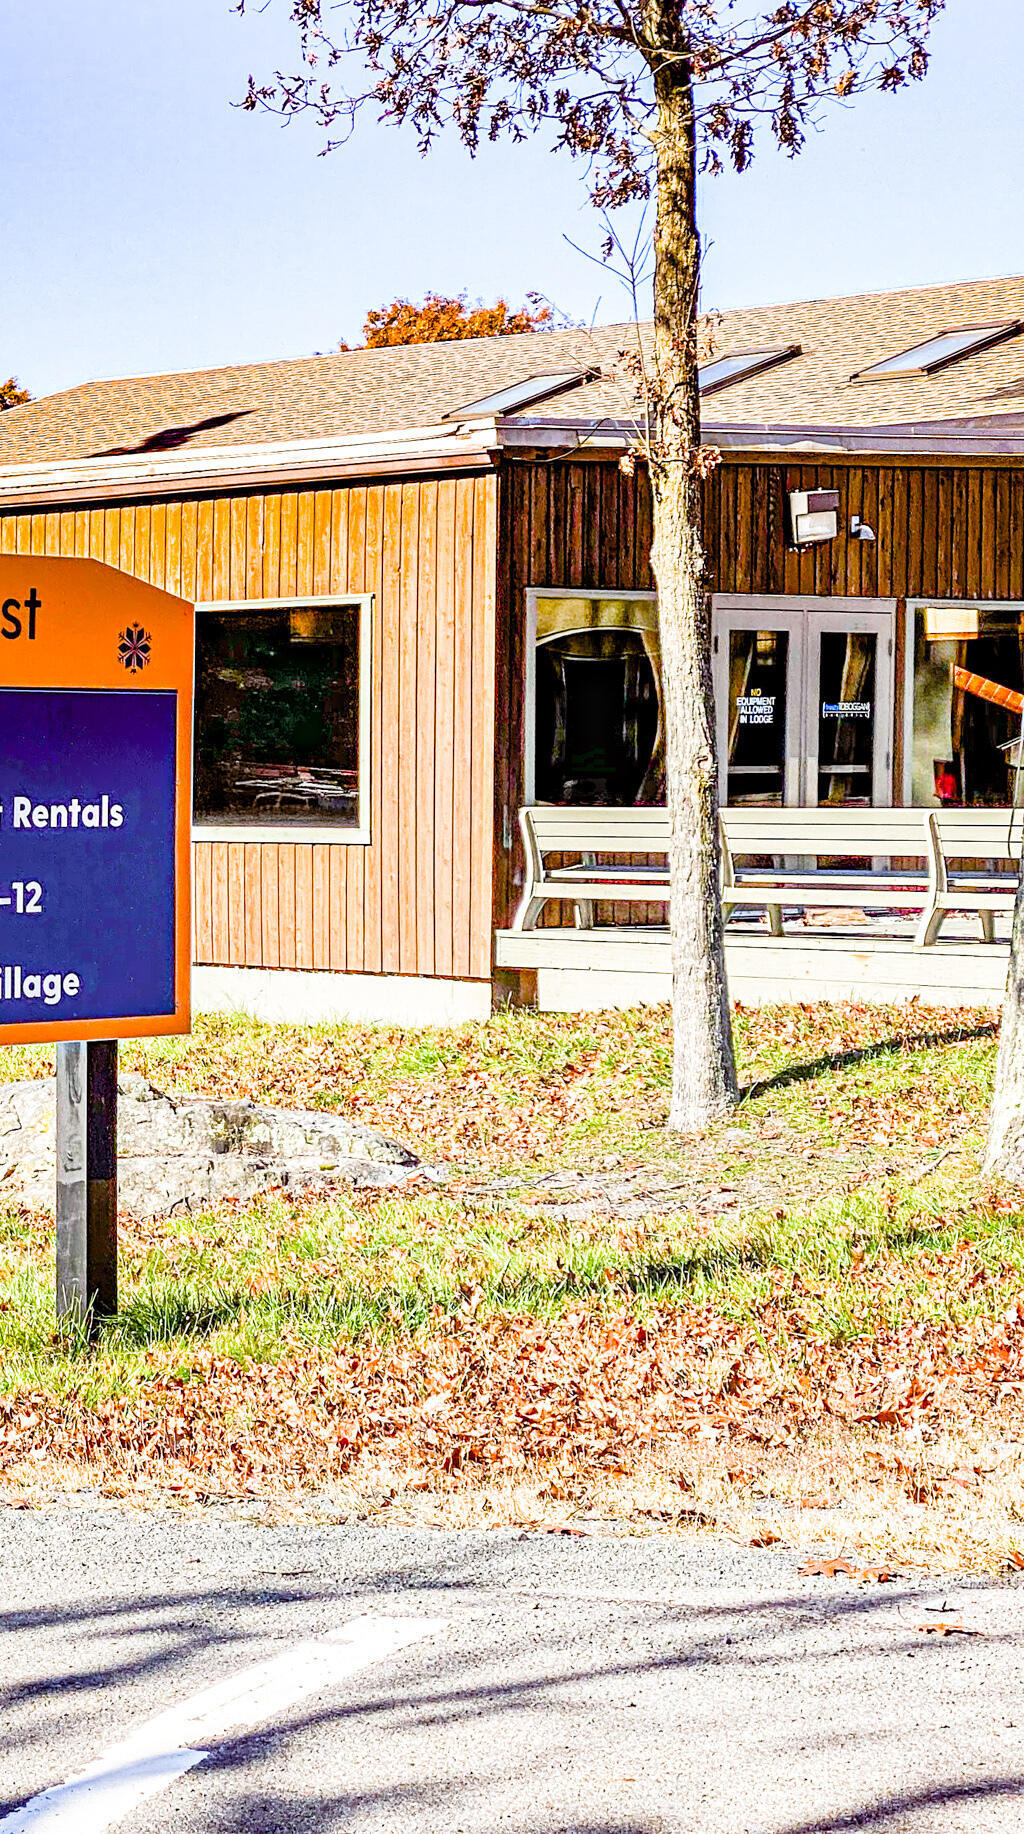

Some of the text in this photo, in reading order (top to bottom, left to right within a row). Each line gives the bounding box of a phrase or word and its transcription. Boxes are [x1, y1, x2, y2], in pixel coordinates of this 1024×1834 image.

[750, 688, 761, 696] NO
[736, 696, 776, 705] EQUIPMENT
[740, 705, 773, 714] ALLOWED
[739, 714, 774, 723] IN LODGE
[13, 794, 125, 829] Rentals
